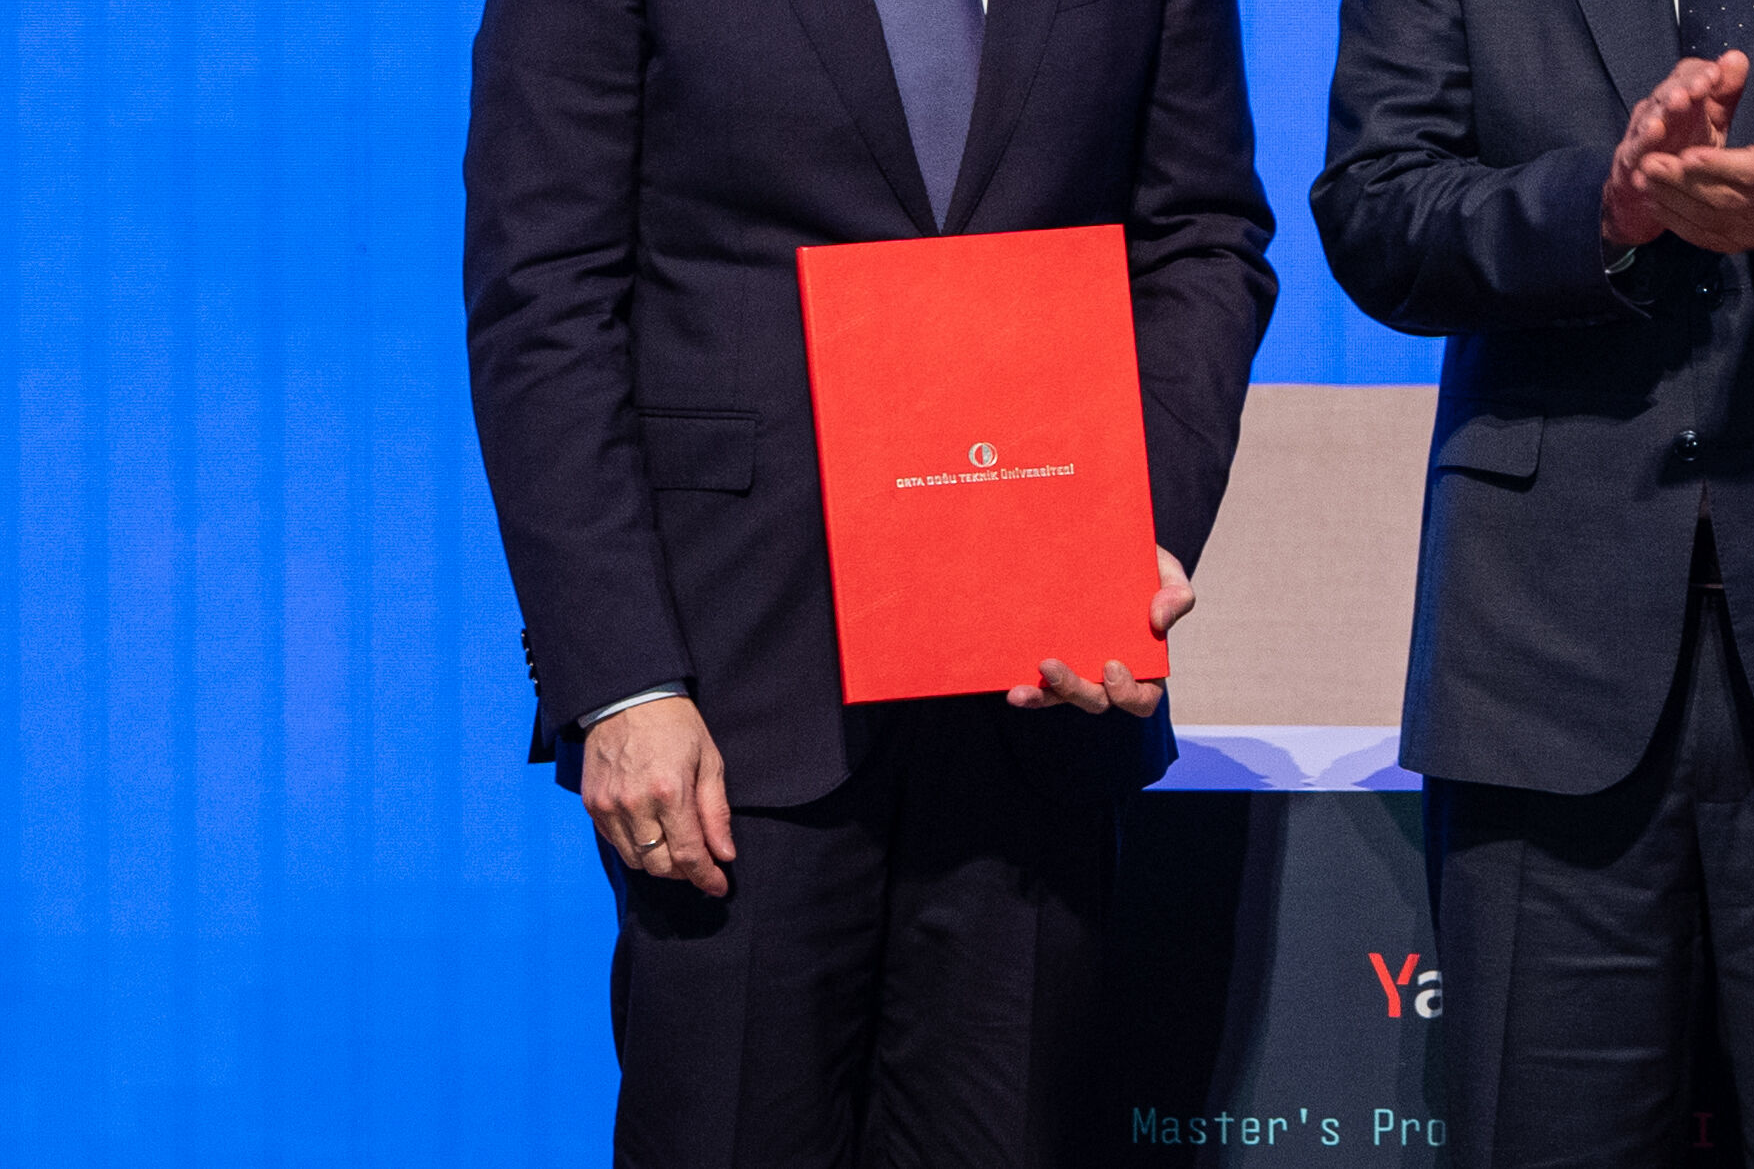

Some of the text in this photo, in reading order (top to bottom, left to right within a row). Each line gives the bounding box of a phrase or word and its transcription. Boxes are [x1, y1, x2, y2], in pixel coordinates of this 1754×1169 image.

[896, 477, 925, 489] ORTA
[926, 472, 957, 486] DOĞU
[958, 470, 999, 483] TEKNİK
[1131, 1106, 1341, 1147] Master's
